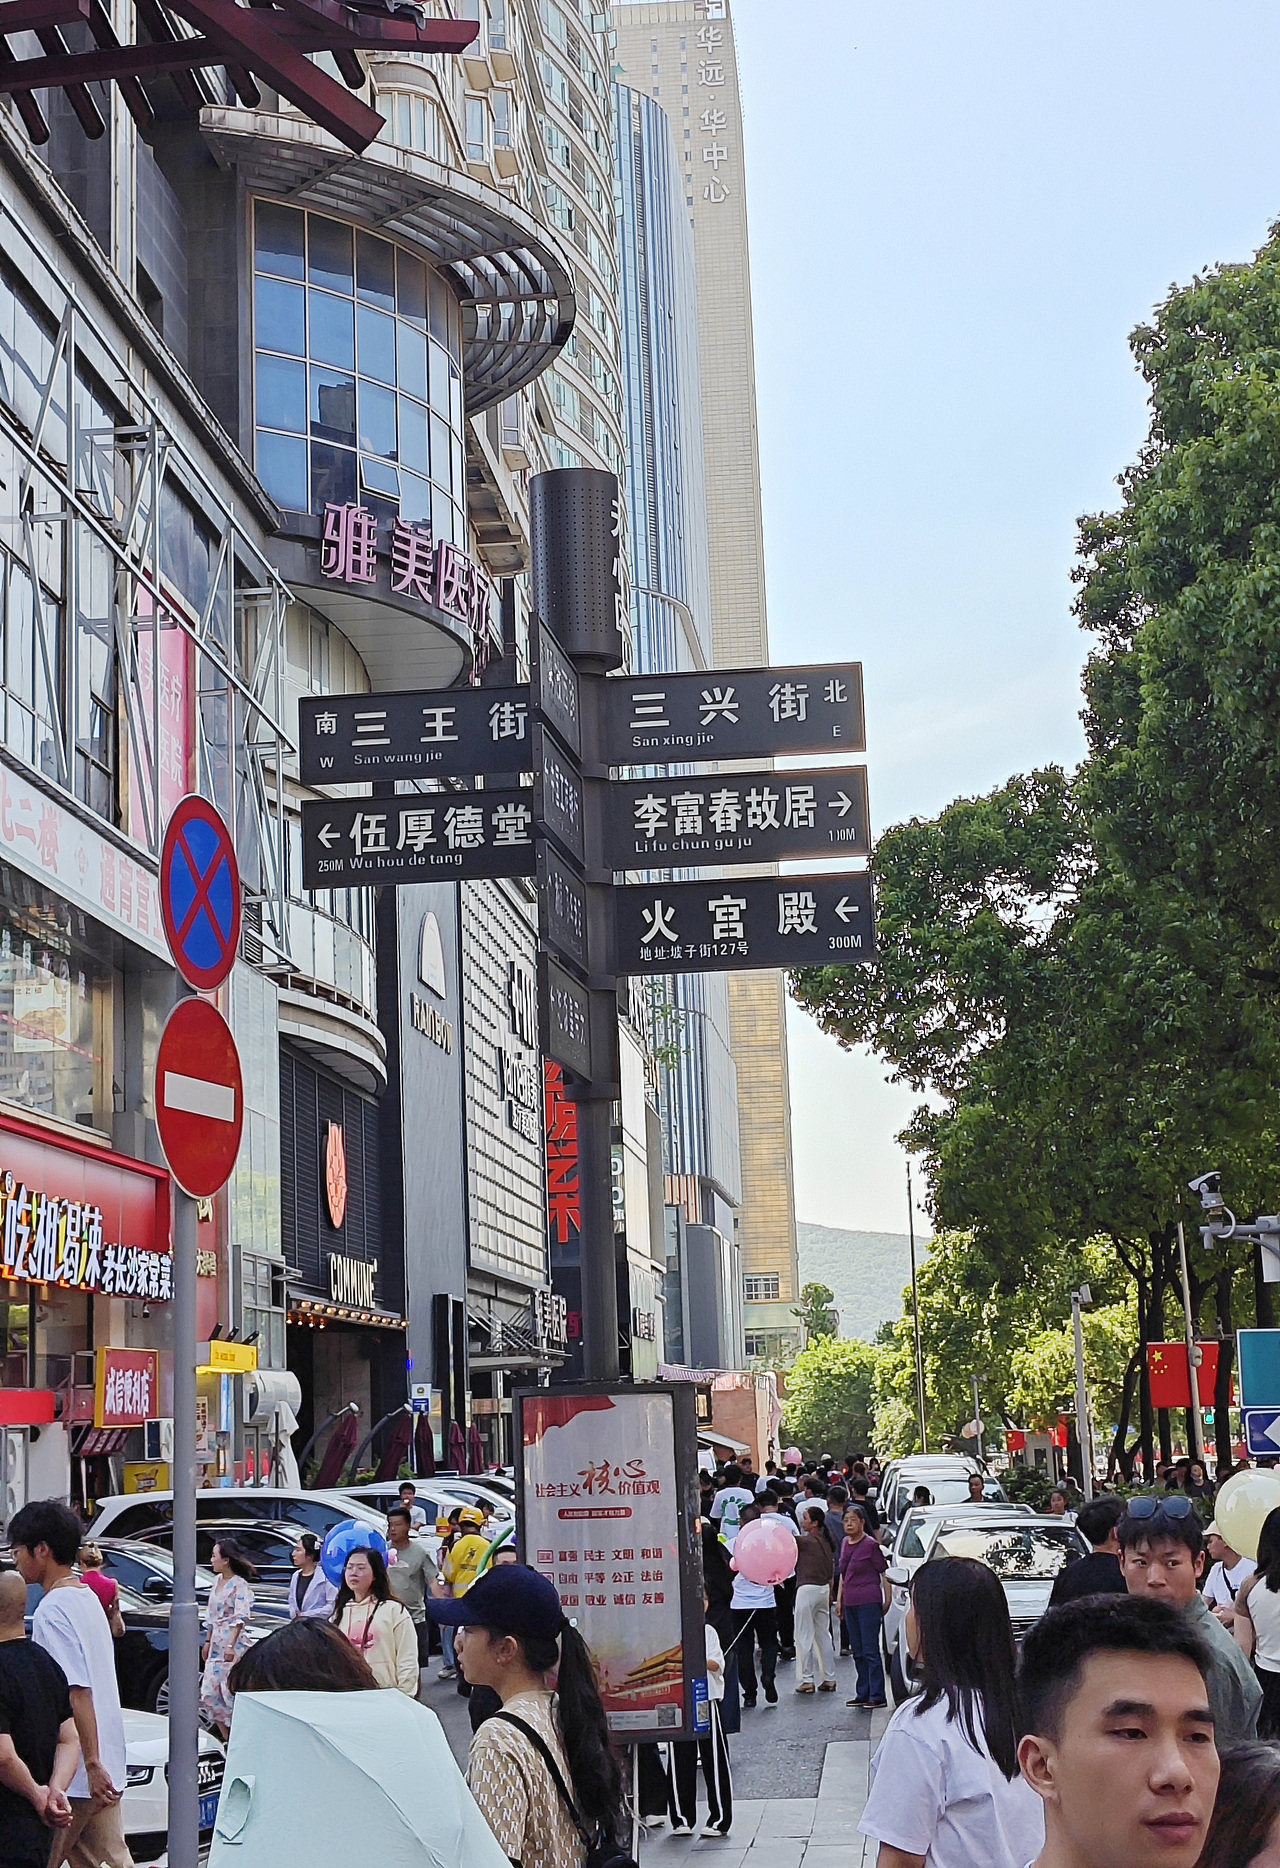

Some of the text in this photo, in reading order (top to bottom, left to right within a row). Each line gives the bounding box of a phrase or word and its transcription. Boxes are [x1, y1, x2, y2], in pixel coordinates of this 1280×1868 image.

[824, 679, 848, 703] 北
[630, 683, 809, 729] 三兴街
[315, 711, 338, 735] 南
[351, 702, 529, 747] 三王街
[832, 725, 842, 737] E
[632, 732, 714, 747] San xing jie
[319, 757, 334, 768] W
[354, 749, 443, 765] San wang jie
[633, 785, 818, 838] 李富春故居
[349, 802, 532, 855] 伍厚德堂
[635, 836, 752, 853] Li fu chun gu ju
[318, 859, 344, 873] 250M
[350, 853, 463, 869] Wu hou de tang
[828, 935, 862, 949] 300M
[330, 1252, 376, 1309] COMMUNE
[584, 1550, 605, 1561] 民主
[612, 1548, 634, 1560] 文明
[559, 1573, 578, 1584] 自由
[584, 1572, 606, 1584] 平等
[612, 1571, 634, 1583] 公正
[641, 1570, 663, 1582] 法治
[585, 1594, 606, 1606] 敬业
[613, 1594, 636, 1605] 诚信
[642, 1592, 664, 1604] 友善
